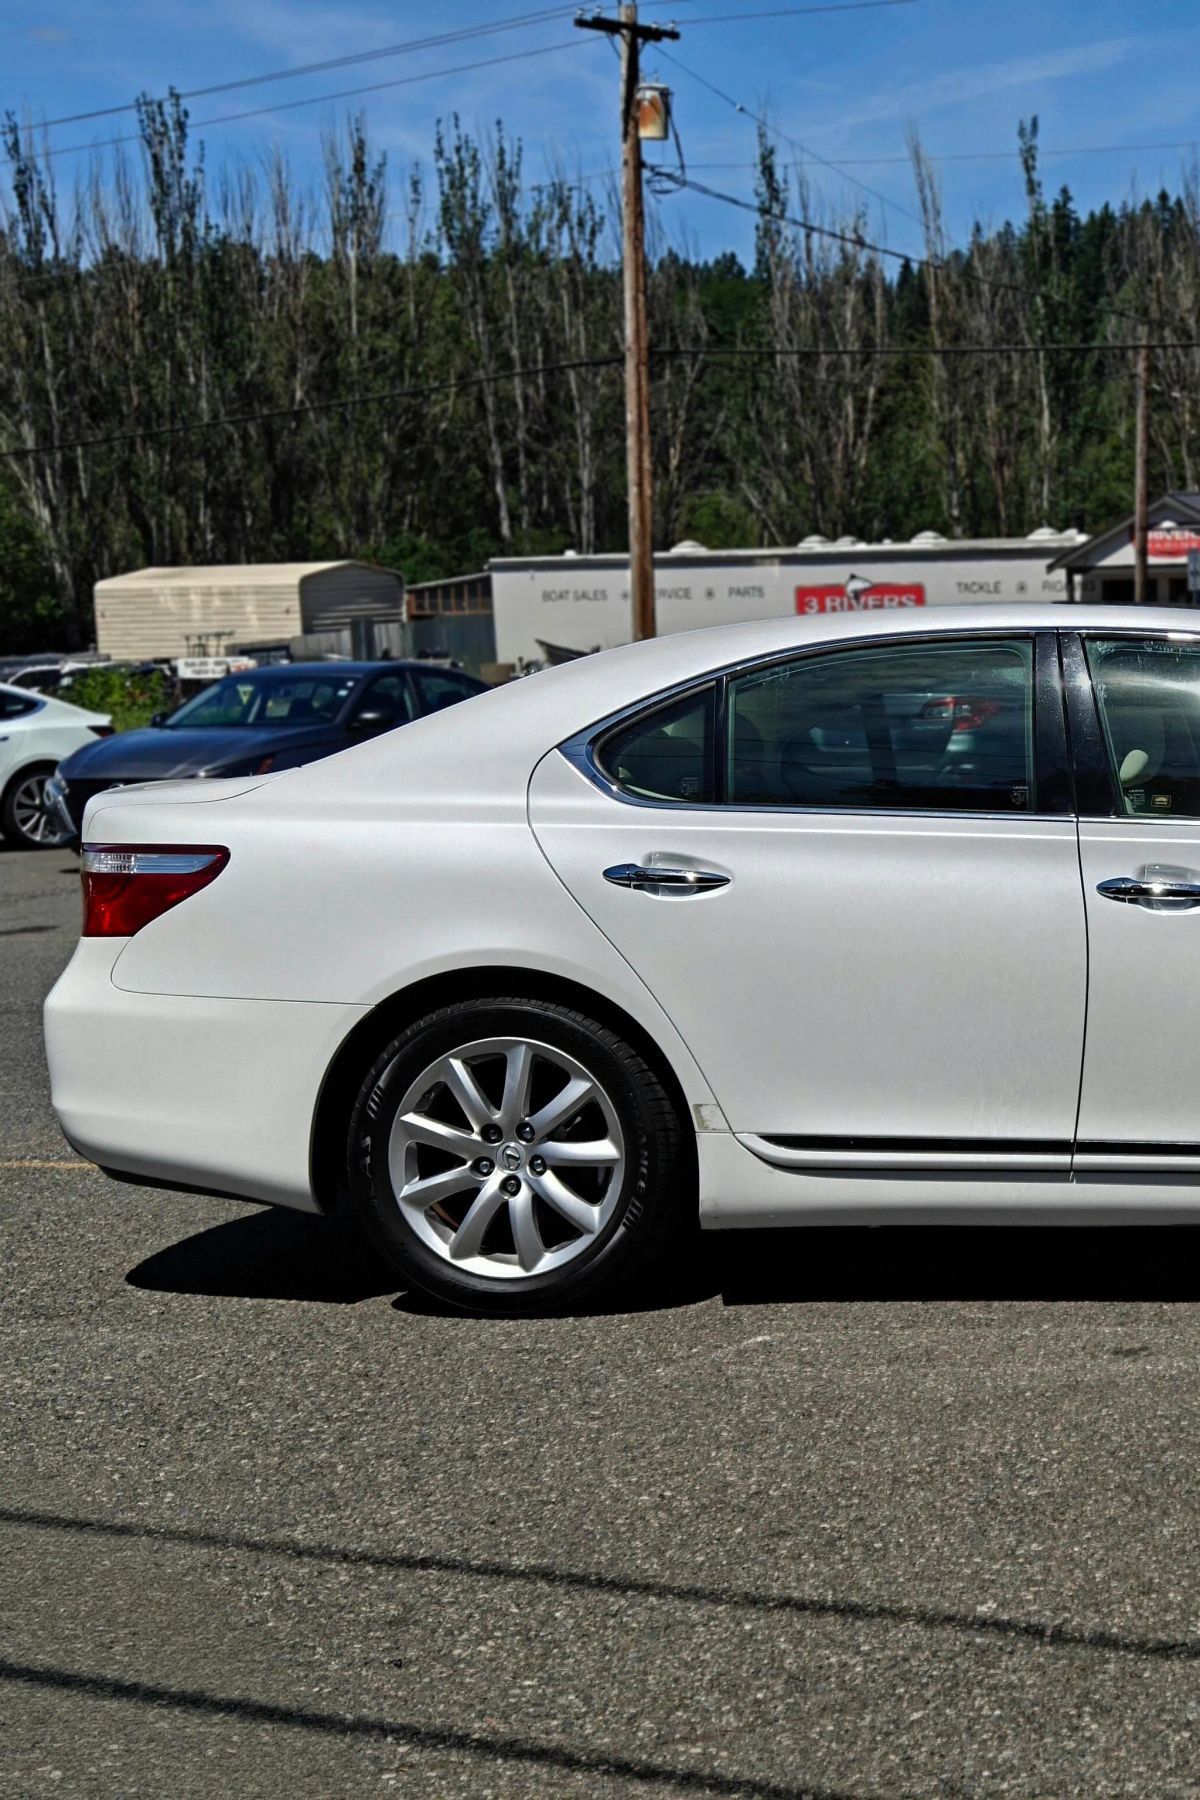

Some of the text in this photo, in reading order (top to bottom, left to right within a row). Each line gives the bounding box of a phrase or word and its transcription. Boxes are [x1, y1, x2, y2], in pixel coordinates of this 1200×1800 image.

[542, 589, 570, 602] BOAT
[573, 588, 608, 601] SALES
[728, 585, 765, 599] PARTS
[956, 581, 1002, 594] TACKLE
[804, 594, 917, 614] 3 RIVERS
